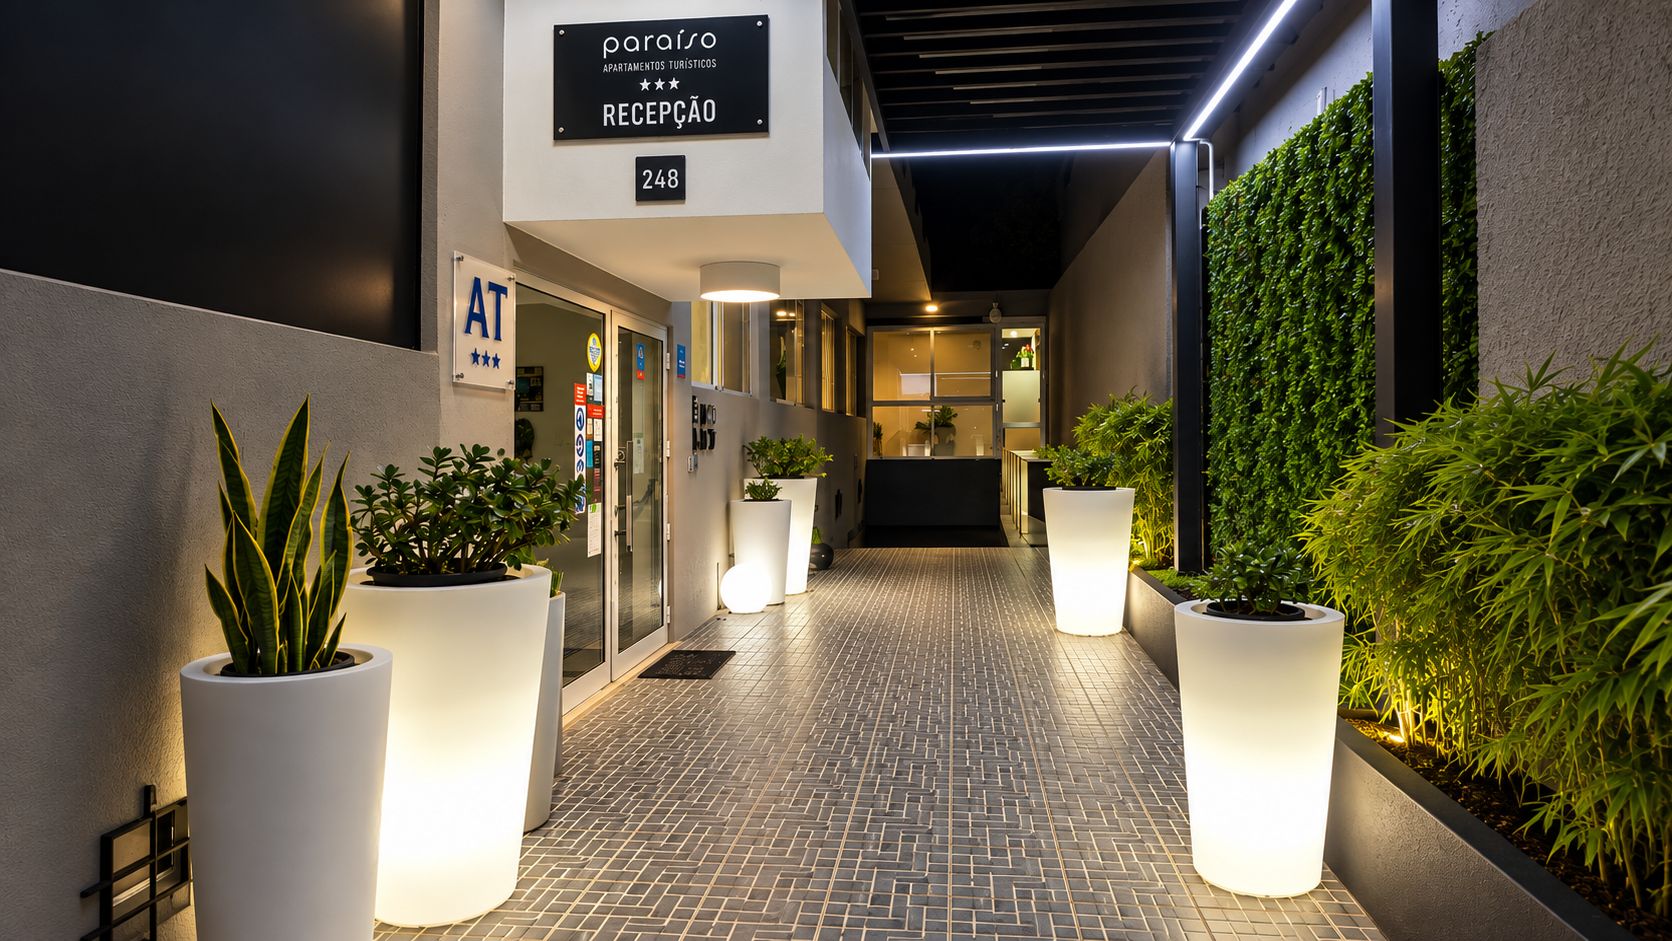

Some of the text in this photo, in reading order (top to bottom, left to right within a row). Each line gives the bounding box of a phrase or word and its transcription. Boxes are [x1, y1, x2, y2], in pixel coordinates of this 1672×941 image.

[603, 29, 717, 59] paraíso
[603, 57, 717, 73] APARTAMENTOS TURÍSTICOS
[603, 95, 717, 129] RECEPÇÃO
[642, 168, 679, 190] 248
[464, 276, 508, 342] AT
